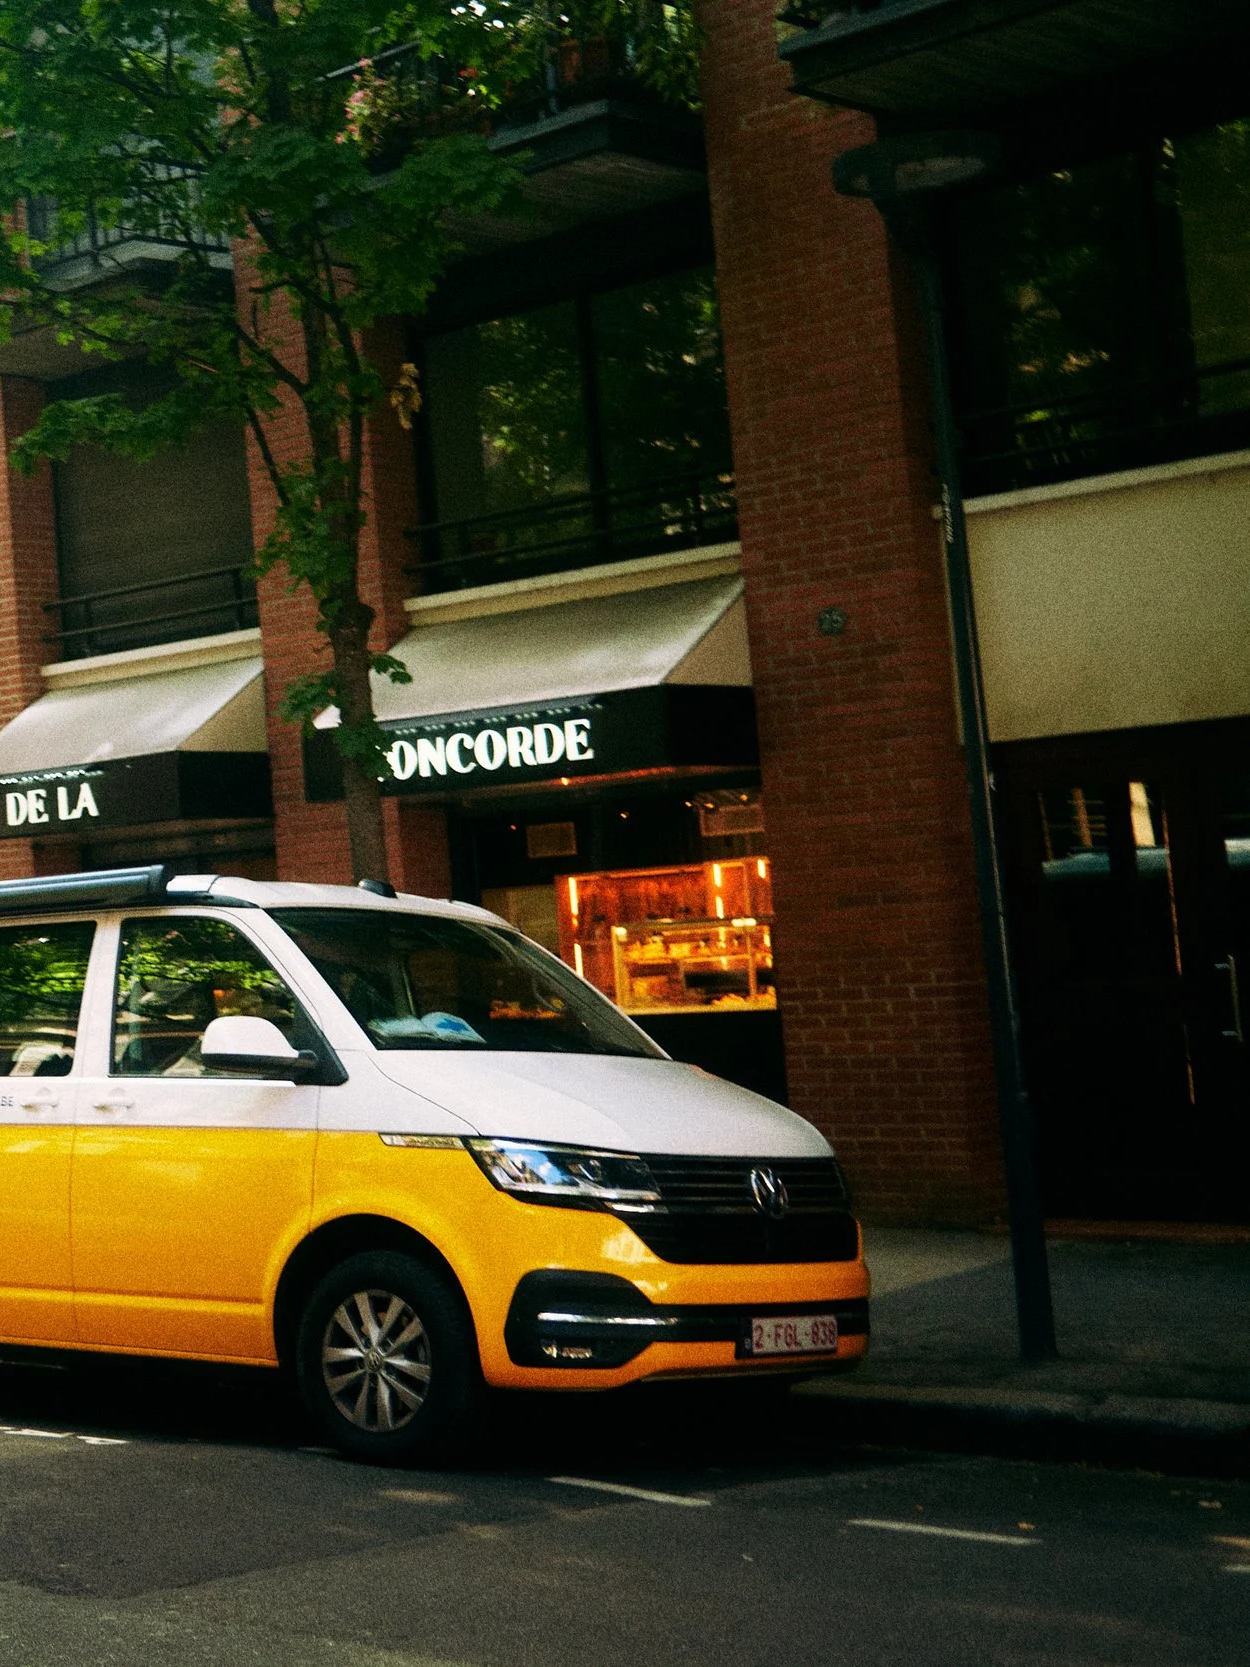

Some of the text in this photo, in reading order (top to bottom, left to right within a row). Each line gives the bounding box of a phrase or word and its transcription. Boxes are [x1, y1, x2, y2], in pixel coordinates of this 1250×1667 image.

[375, 718, 594, 783] ONCORDE
[5, 782, 100, 826] DE LA
